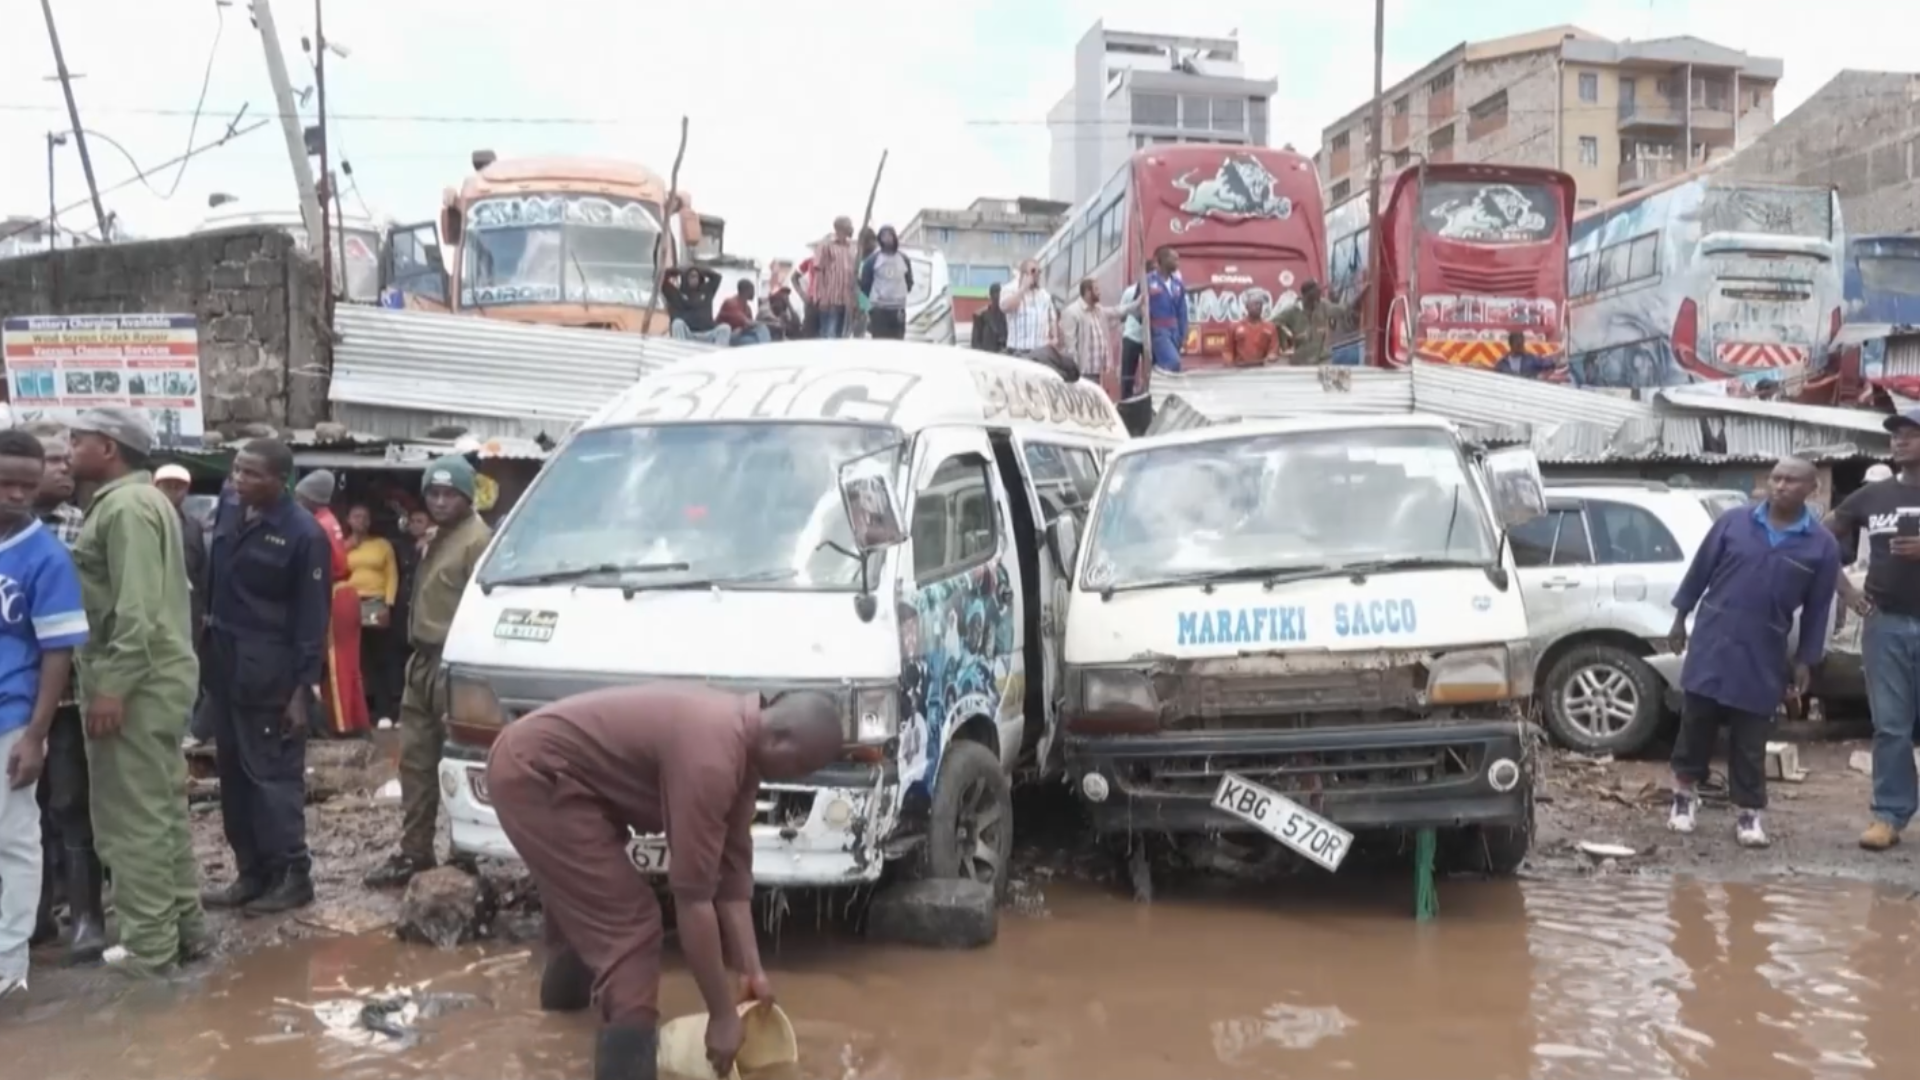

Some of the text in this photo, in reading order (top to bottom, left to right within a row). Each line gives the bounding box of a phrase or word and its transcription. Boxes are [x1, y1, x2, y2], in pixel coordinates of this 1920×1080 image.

[28, 316, 171, 331] Battery Charging Available
[32, 332, 168, 343] Wind Screen Crack Repair
[125, 345, 170, 356] Services
[603, 367, 921, 424] BIG
[1178, 599, 1417, 645] MARAFIKI SACCO
[1219, 779, 1343, 862] KBG 570R
